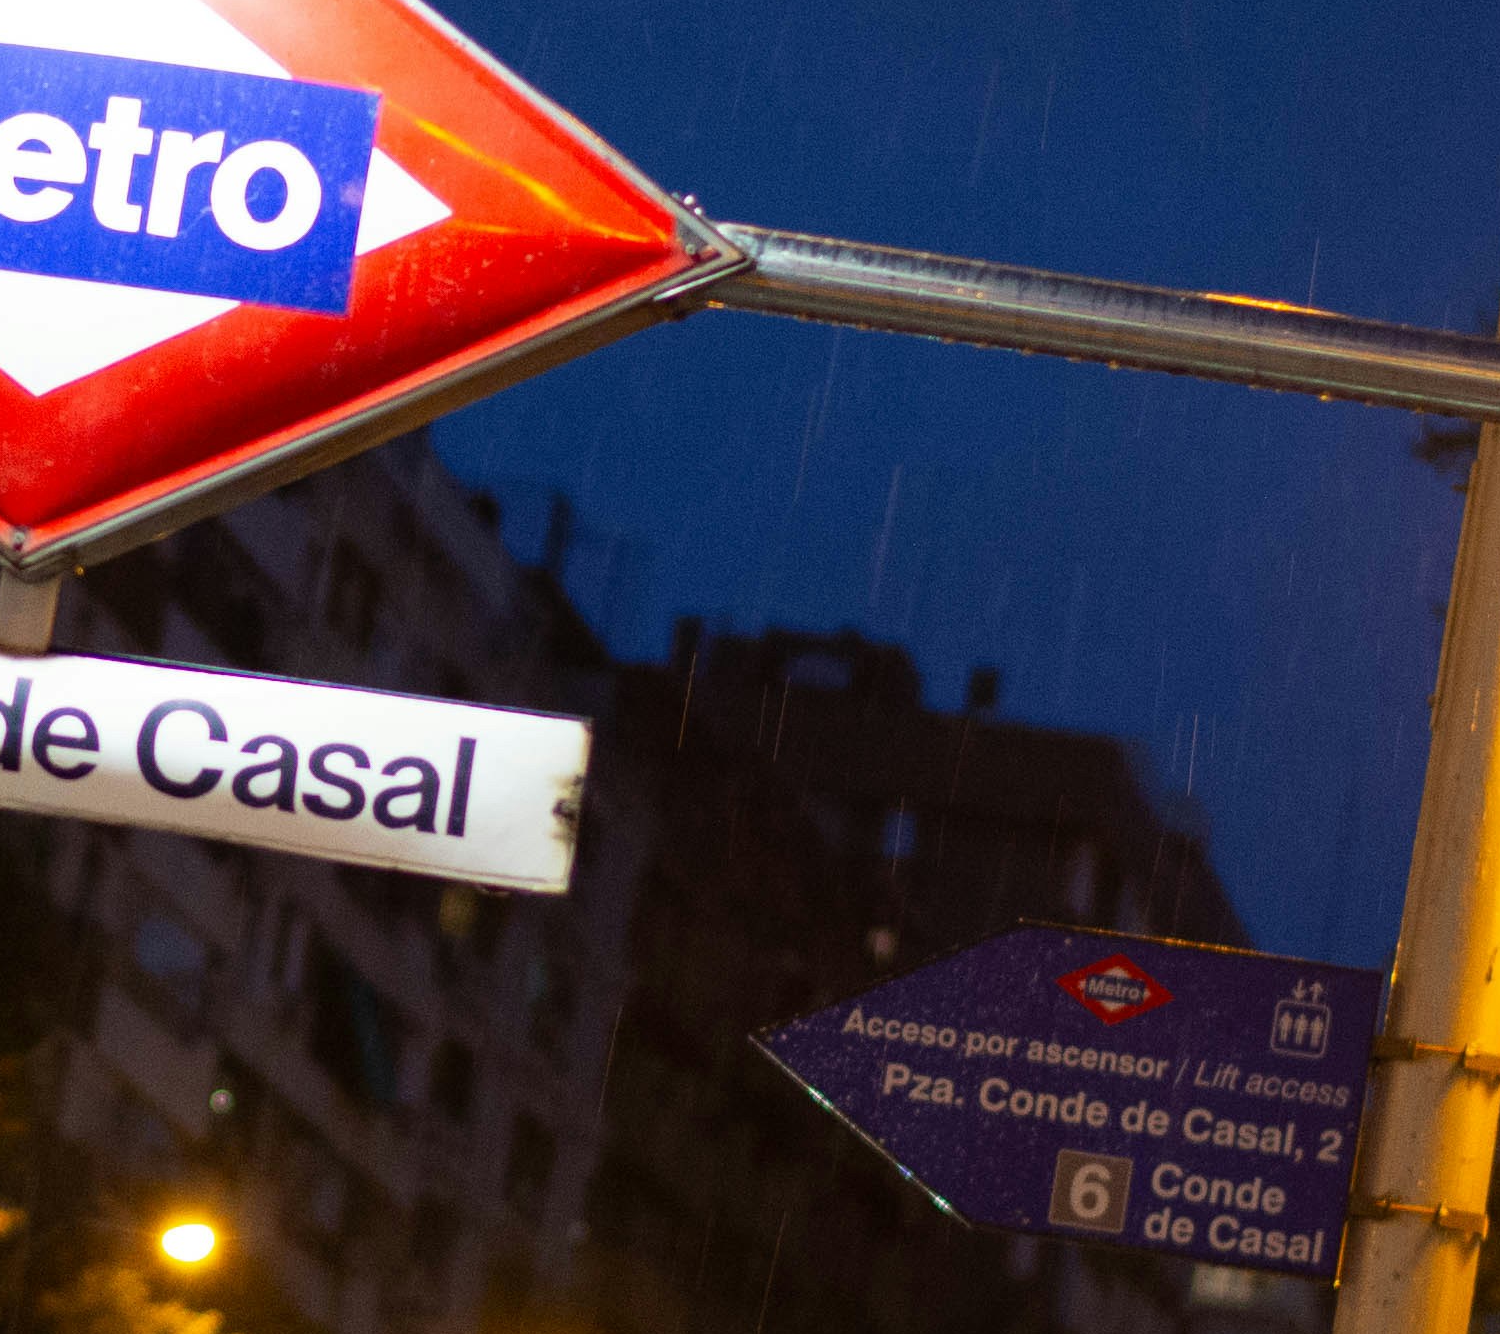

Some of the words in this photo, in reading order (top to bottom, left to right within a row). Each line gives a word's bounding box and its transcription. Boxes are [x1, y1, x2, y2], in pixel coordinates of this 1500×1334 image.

[136, 698, 479, 838] Casal
[1087, 977, 1141, 1000] Metro
[841, 1006, 957, 1048] Acceso
[963, 1029, 1018, 1058] por
[1026, 1039, 1170, 1080] ascensor
[1193, 1059, 1241, 1091] Lift
[1244, 1072, 1350, 1108] access
[882, 1062, 964, 1106] Pza.
[978, 1077, 1110, 1129] Conde
[1119, 1100, 1171, 1137] de
[1182, 1108, 1304, 1163] Casal,
[1315, 1128, 1343, 1164] 2
[1068, 1162, 1112, 1220] 6
[1150, 1162, 1287, 1216] Conde
[1143, 1206, 1196, 1245] de
[1207, 1215, 1326, 1265] Casal
